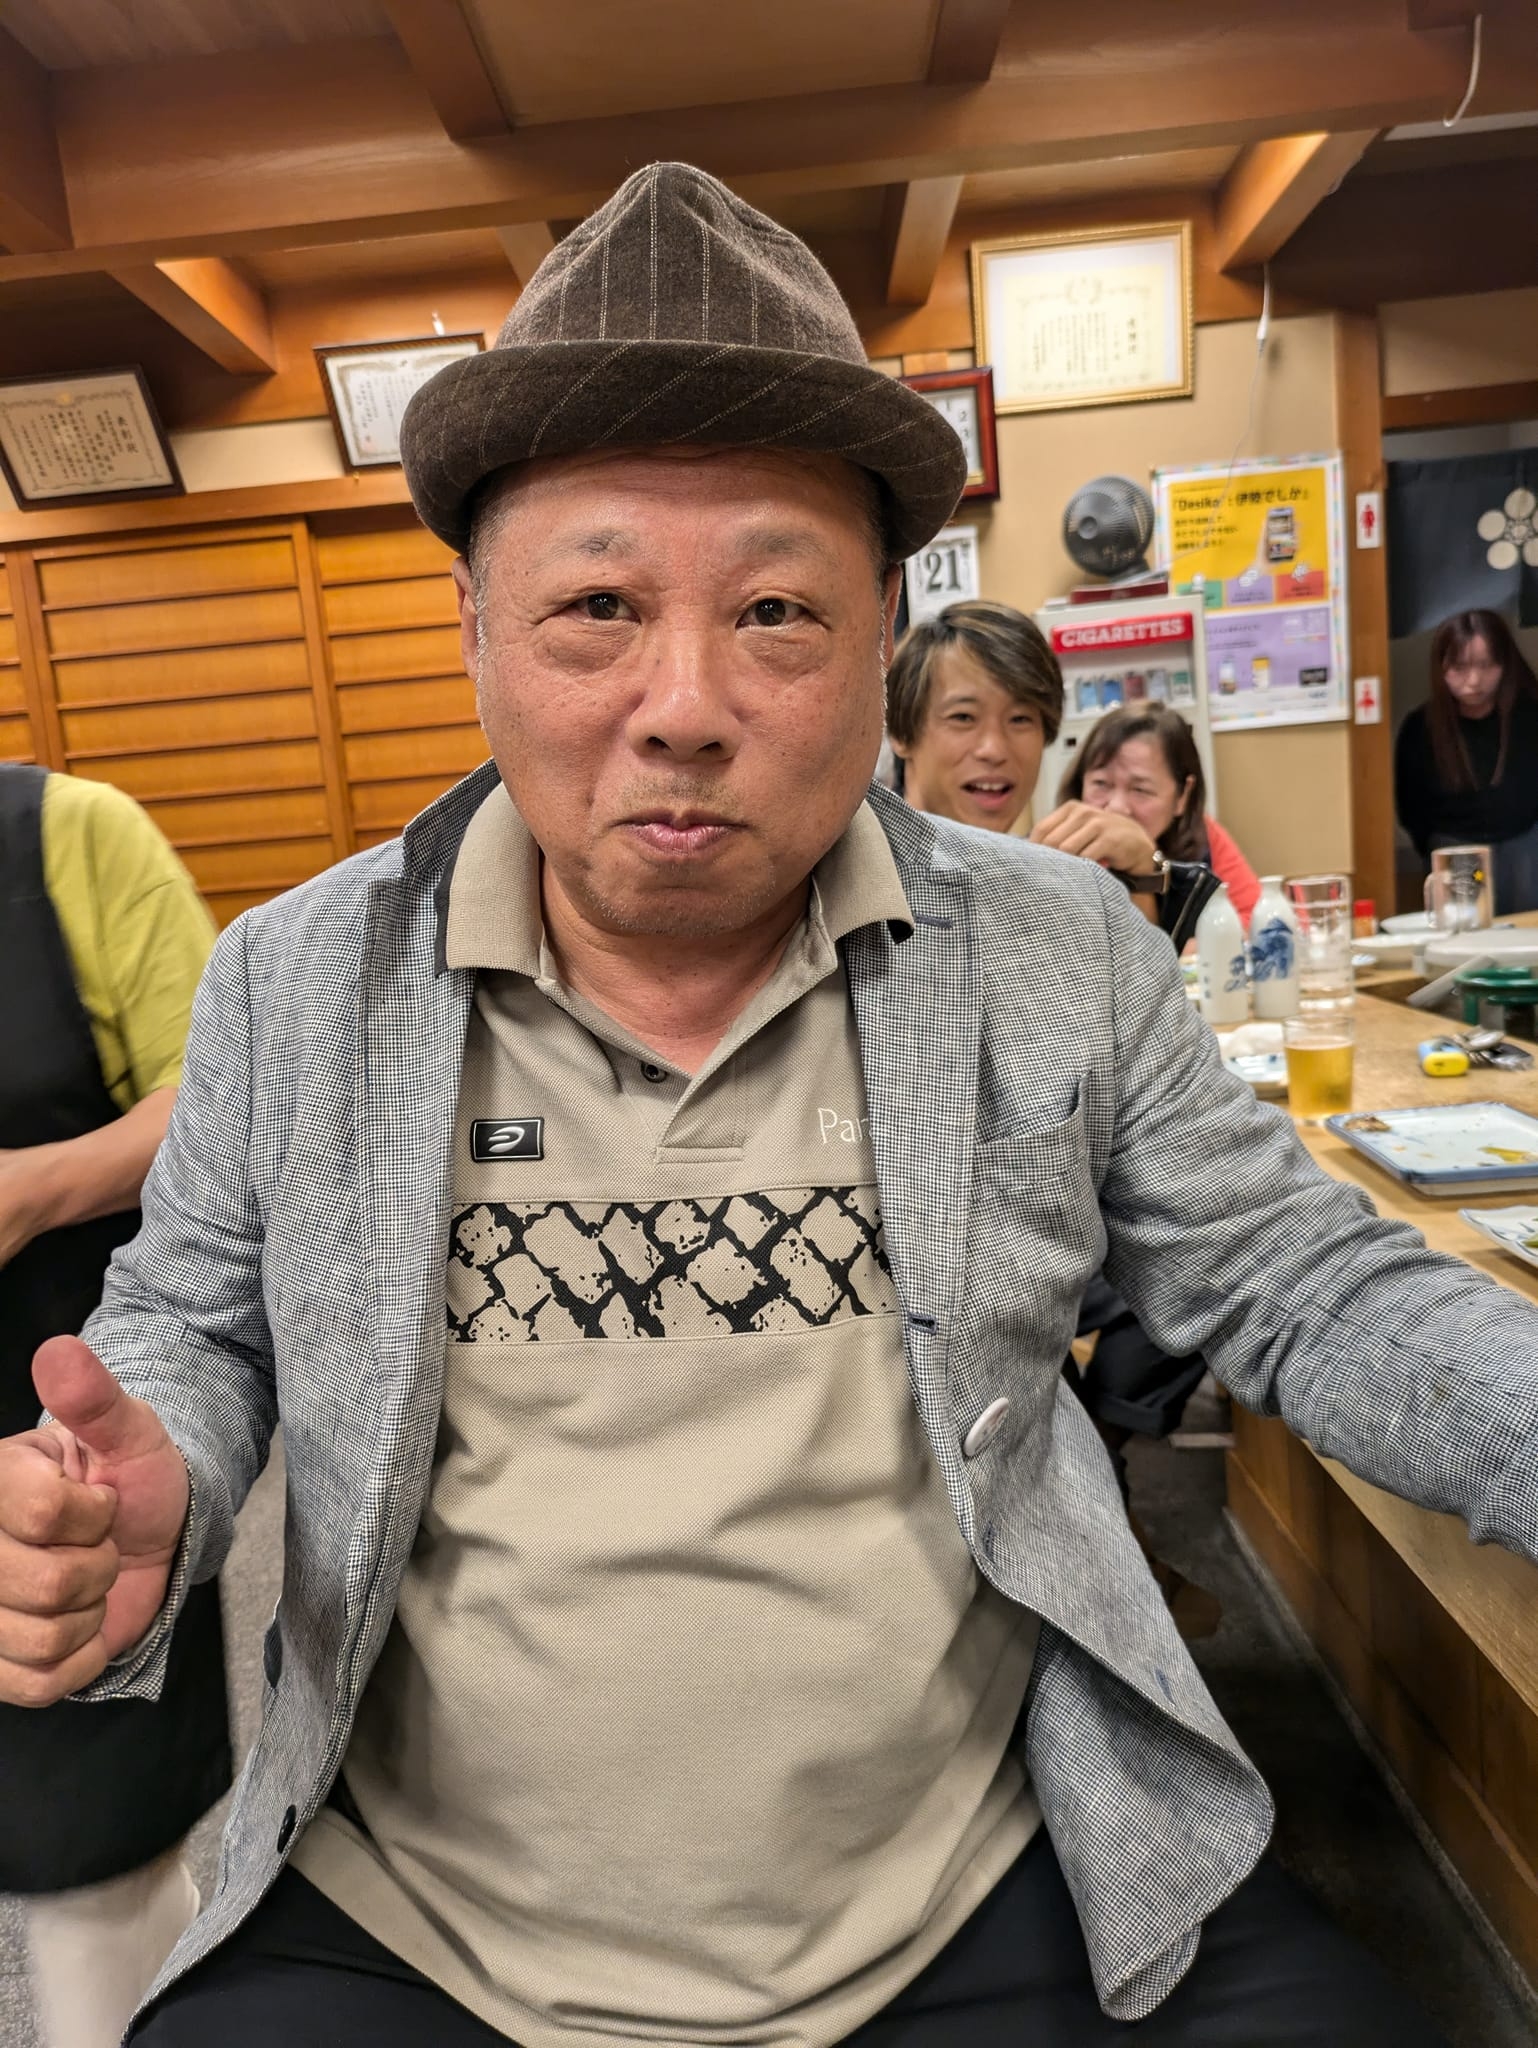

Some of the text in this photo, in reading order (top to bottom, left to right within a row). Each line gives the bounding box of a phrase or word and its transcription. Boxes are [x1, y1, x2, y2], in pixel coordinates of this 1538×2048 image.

[959, 410, 968, 423] 2
[925, 548, 963, 594] 21
[1060, 617, 1185, 648] CIGARETTES
[817, 1107, 873, 1144] Par
